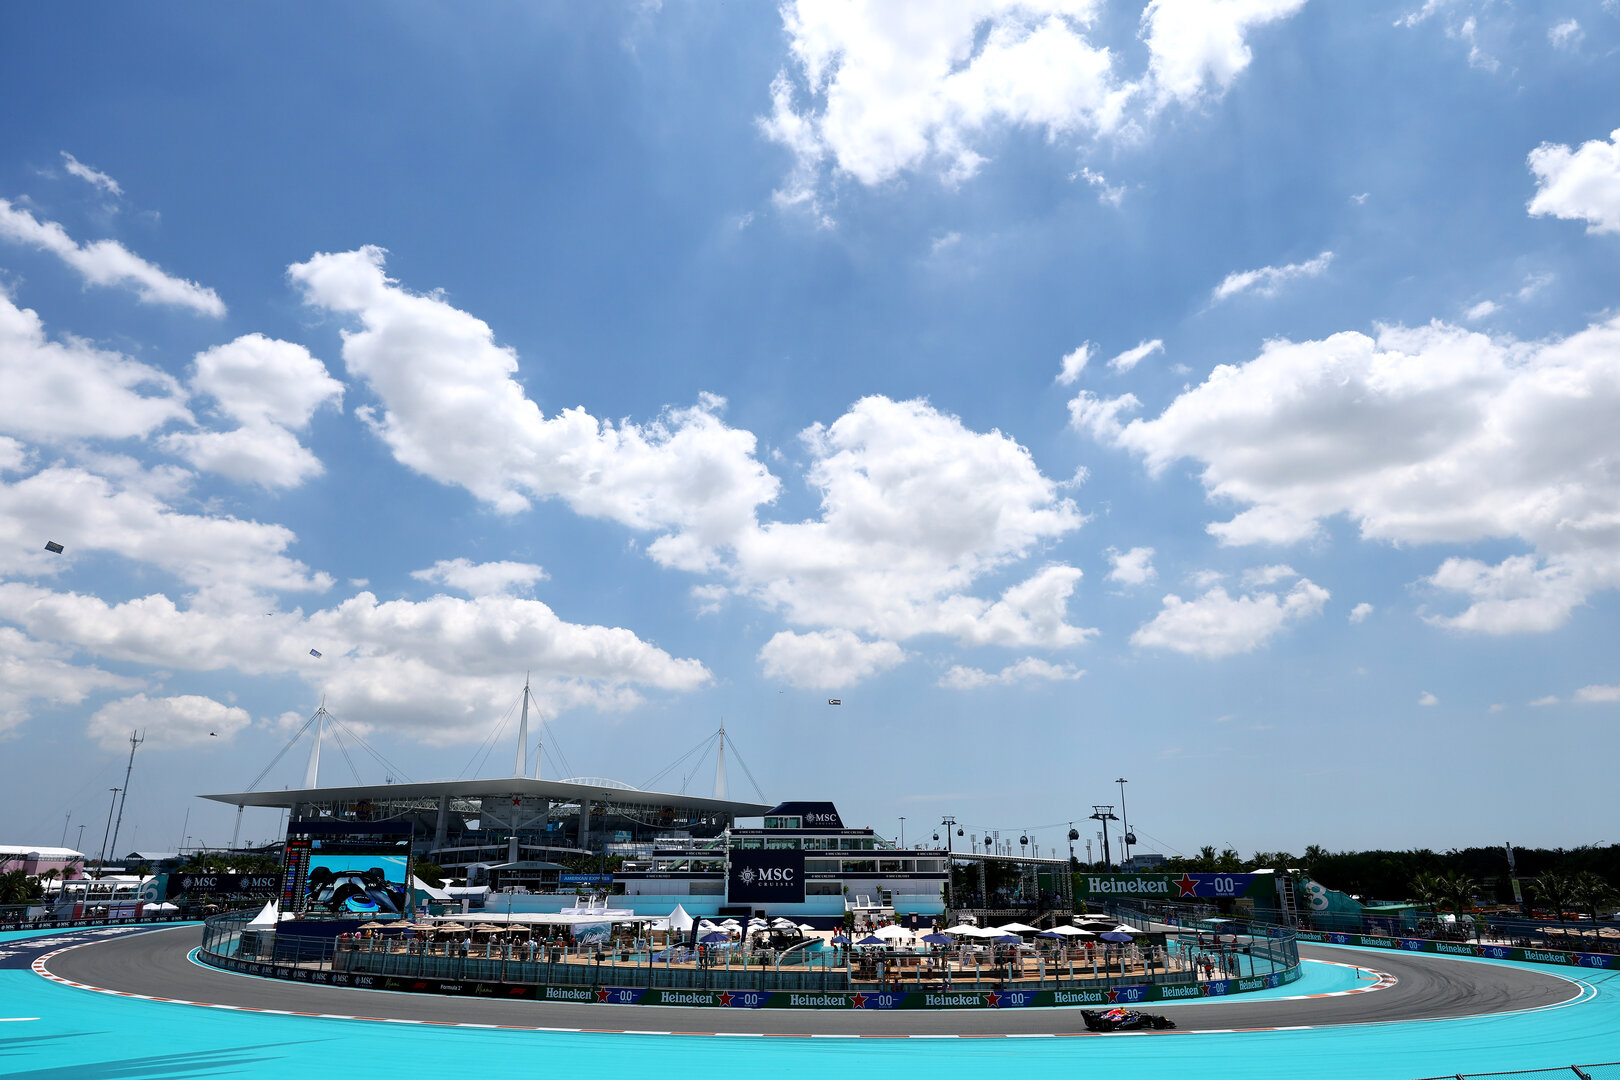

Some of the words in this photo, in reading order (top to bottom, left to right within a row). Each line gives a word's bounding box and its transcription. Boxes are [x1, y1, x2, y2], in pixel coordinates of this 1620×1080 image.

[815, 813, 837, 822] MSC
[758, 868, 794, 880] MSC
[194, 877, 217, 886] MSC
[251, 877, 276, 886] MSC
[1088, 877, 1169, 893] Heineken
[1214, 878, 1234, 892] 0.0
[1306, 881, 1328, 910] 8
[1360, 936, 1392, 947] Heineken
[1436, 943, 1472, 954] Heineken
[1493, 947, 1503, 957] 0.0
[1524, 950, 1566, 963] Heineken
[1591, 956, 1603, 966] 0.0
[546, 987, 592, 1000] Heineken
[620, 990, 632, 1001] 0.0
[1054, 992, 1102, 1003] Heineken
[1127, 989, 1138, 1000] 0.0
[1162, 986, 1199, 998] Heineken
[1216, 984, 1224, 992] 0.0
[661, 992, 713, 1004] Heineken
[744, 994, 758, 1005] 0.0
[790, 994, 846, 1006] Heineken
[878, 995, 892, 1005] 0.0
[925, 994, 980, 1006] Heineken
[1011, 993, 1024, 1004] 0.0
